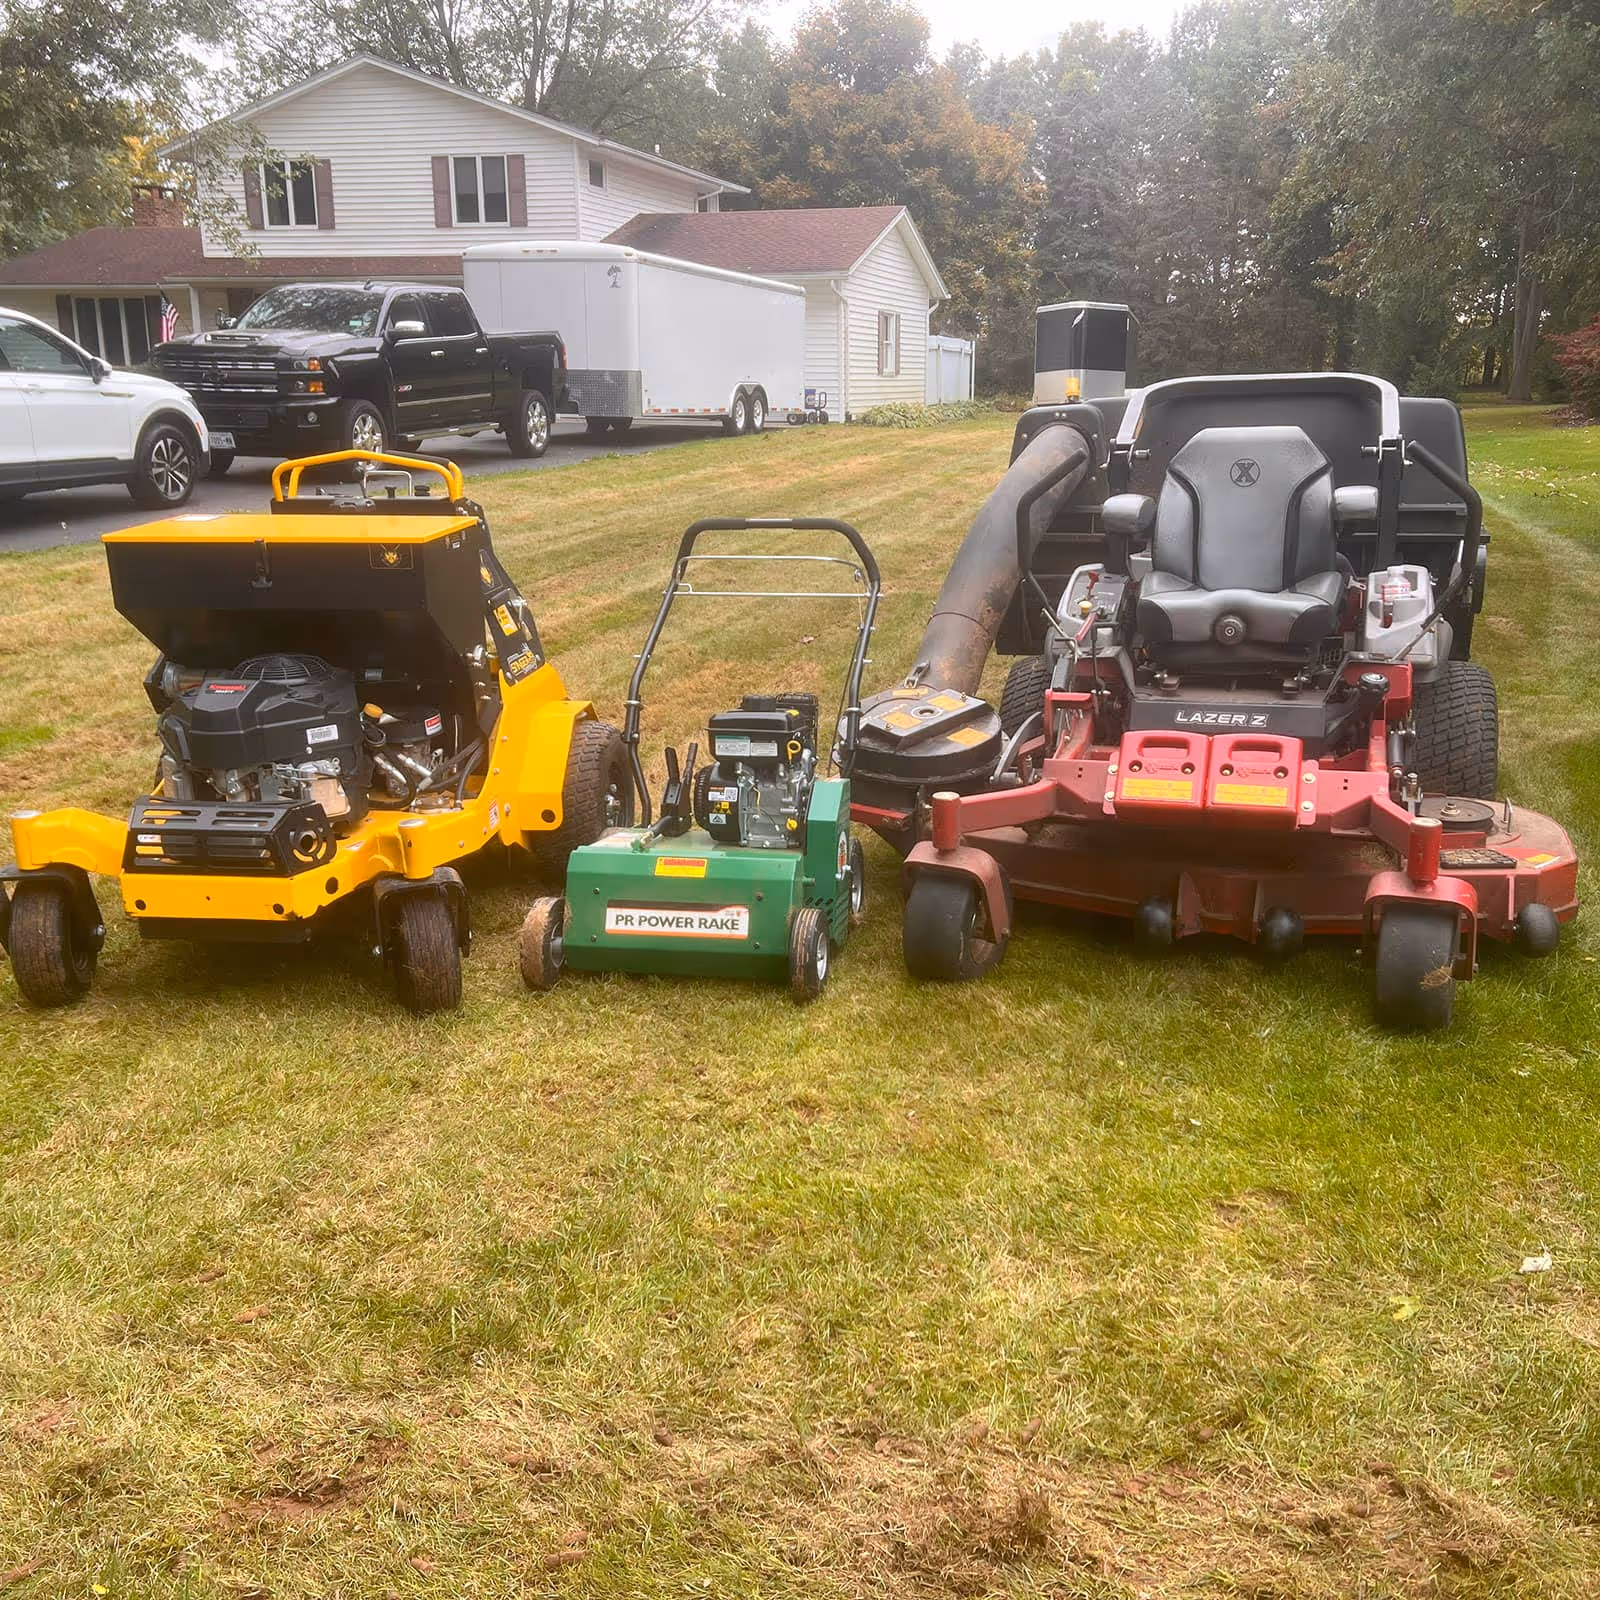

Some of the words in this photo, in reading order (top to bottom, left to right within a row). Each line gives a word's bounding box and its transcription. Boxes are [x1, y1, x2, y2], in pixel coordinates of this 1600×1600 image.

[1176, 711, 1246, 725] LAZER
[1250, 715, 1266, 726] Z
[615, 913, 634, 926] PR
[638, 915, 694, 929] POWER
[698, 917, 740, 931] RAKE
